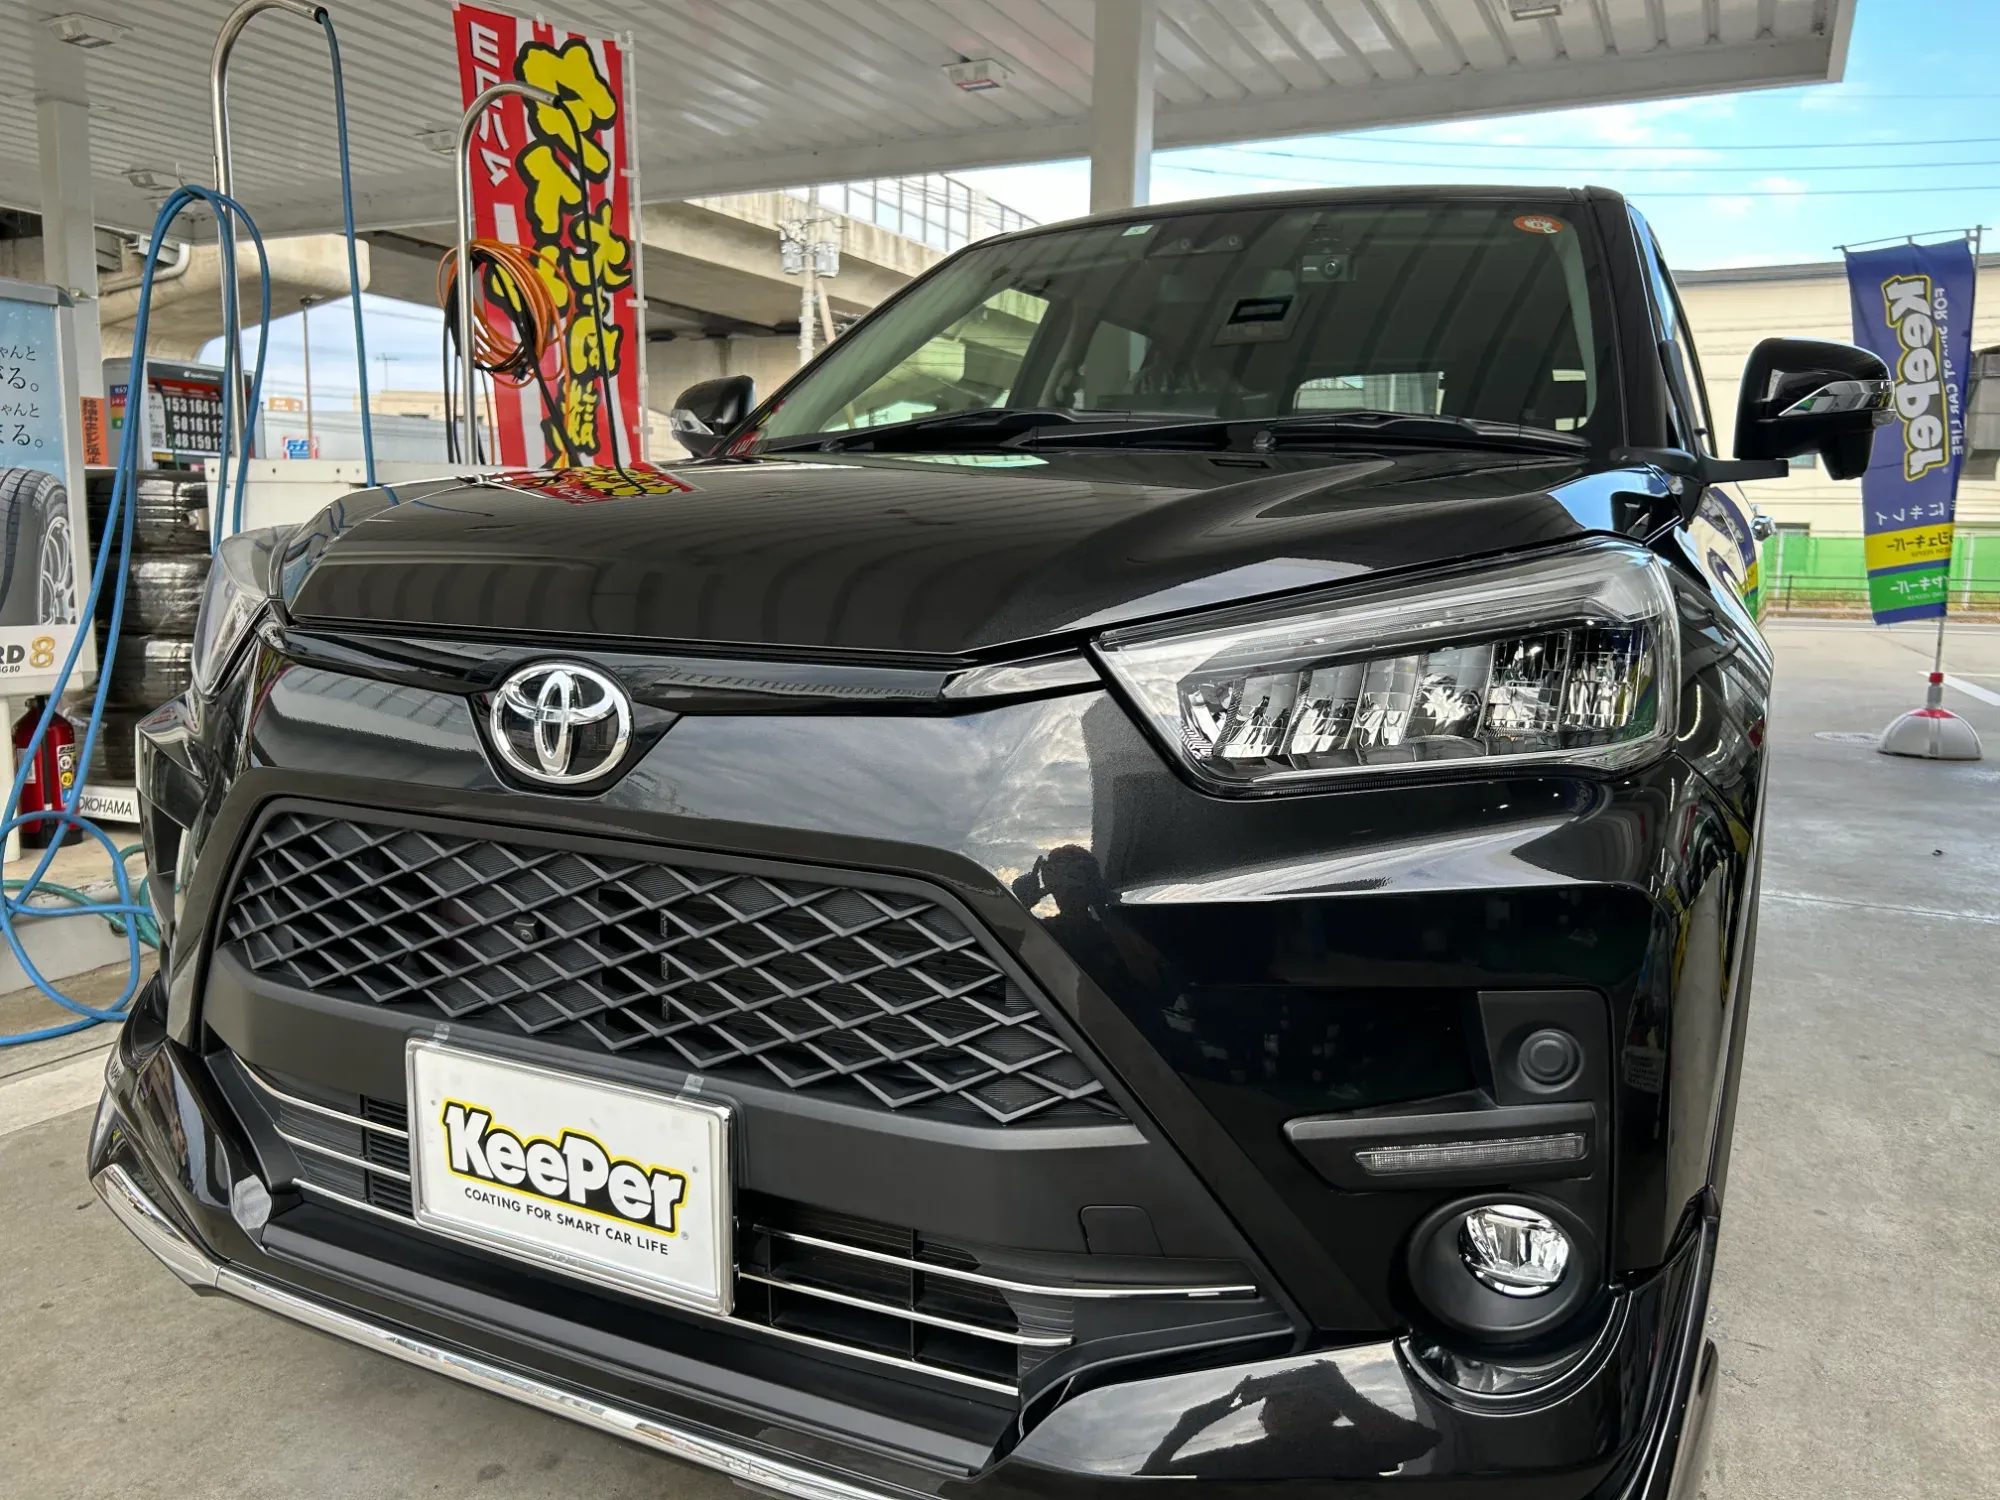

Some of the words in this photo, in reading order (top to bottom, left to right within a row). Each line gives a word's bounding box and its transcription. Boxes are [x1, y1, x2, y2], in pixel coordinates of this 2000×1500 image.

[0, 365, 39, 392] る。
[165, 397, 187, 413] 153
[0, 644, 25, 664] D
[29, 636, 55, 668] 8
[0, 665, 20, 673] G80
[79, 796, 132, 815] OKOHAMA
[442, 1099, 688, 1235] KeePer
[464, 1187, 521, 1212] COATING
[526, 1204, 552, 1221] FOR
[556, 1213, 600, 1235] SMART
[605, 1228, 632, 1245] CAR
[637, 1236, 669, 1255] LIFE
